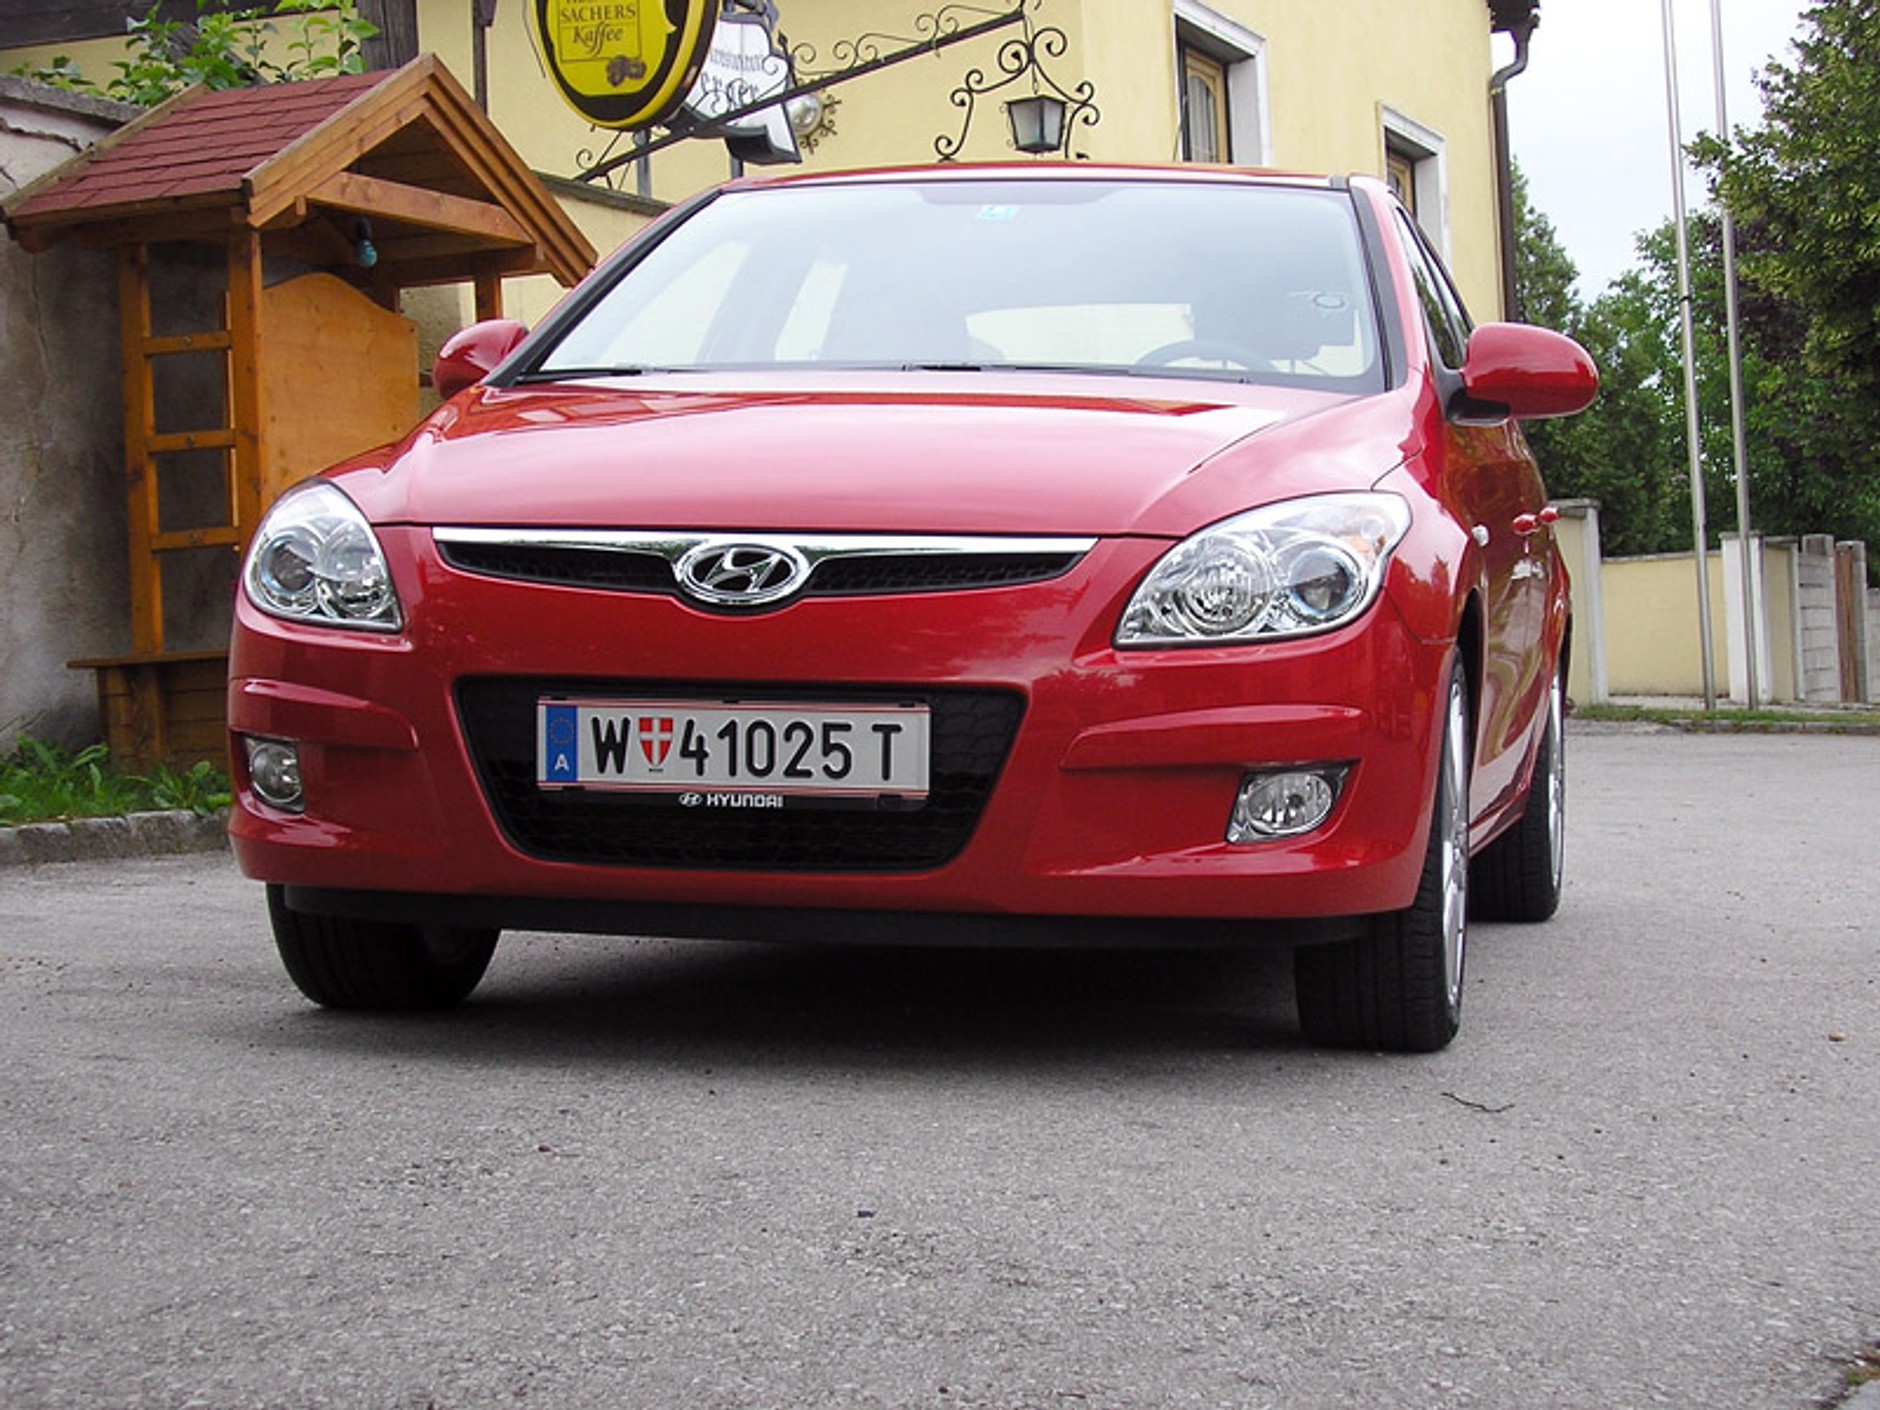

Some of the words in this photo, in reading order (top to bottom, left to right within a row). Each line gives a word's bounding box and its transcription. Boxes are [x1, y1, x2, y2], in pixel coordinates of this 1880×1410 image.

[561, 5, 636, 21] SACHERS
[573, 21, 623, 56] Kaffee
[591, 716, 631, 774] W
[679, 718, 852, 780] 41025
[872, 723, 903, 781] T
[554, 753, 570, 772] A
[706, 794, 784, 808] HYUNDAI
